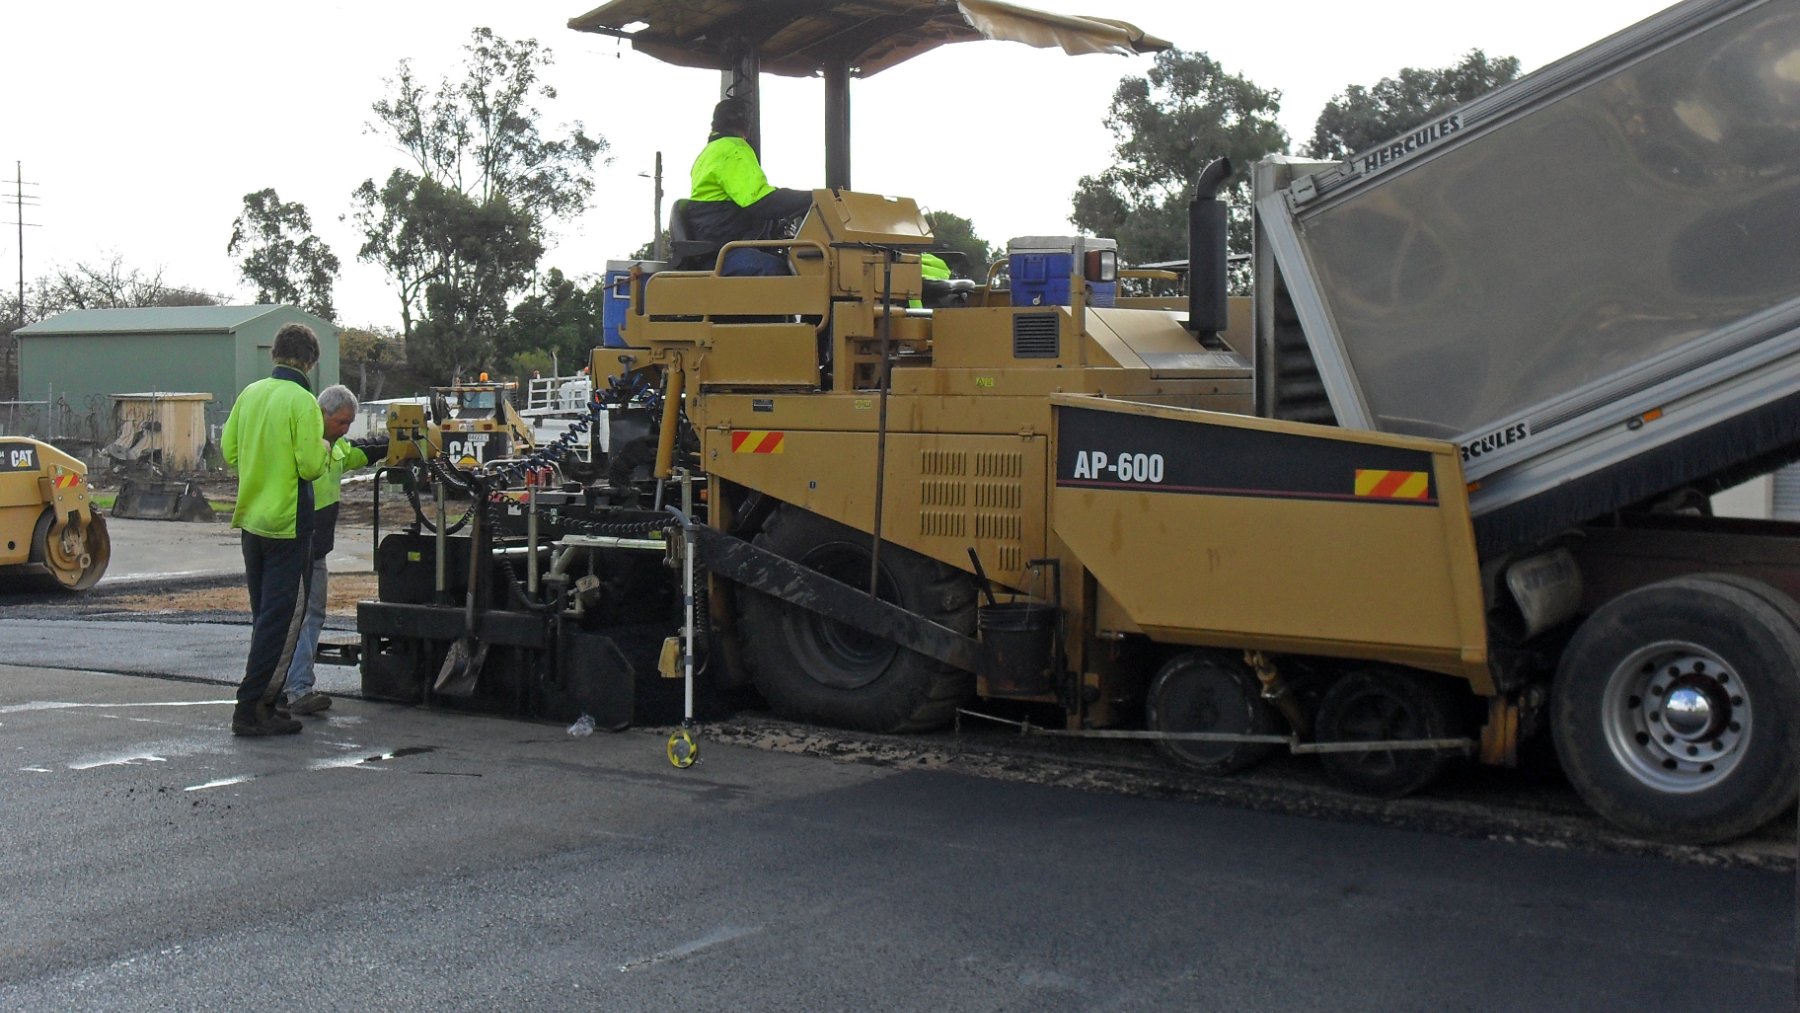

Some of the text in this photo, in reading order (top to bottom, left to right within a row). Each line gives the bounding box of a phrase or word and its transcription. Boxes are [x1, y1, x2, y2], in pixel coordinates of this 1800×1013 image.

[1364, 115, 1460, 174] HERCULES
[11, 449, 33, 467] CAT
[449, 440, 486, 464] CAT
[1073, 450, 1164, 483] AP-600
